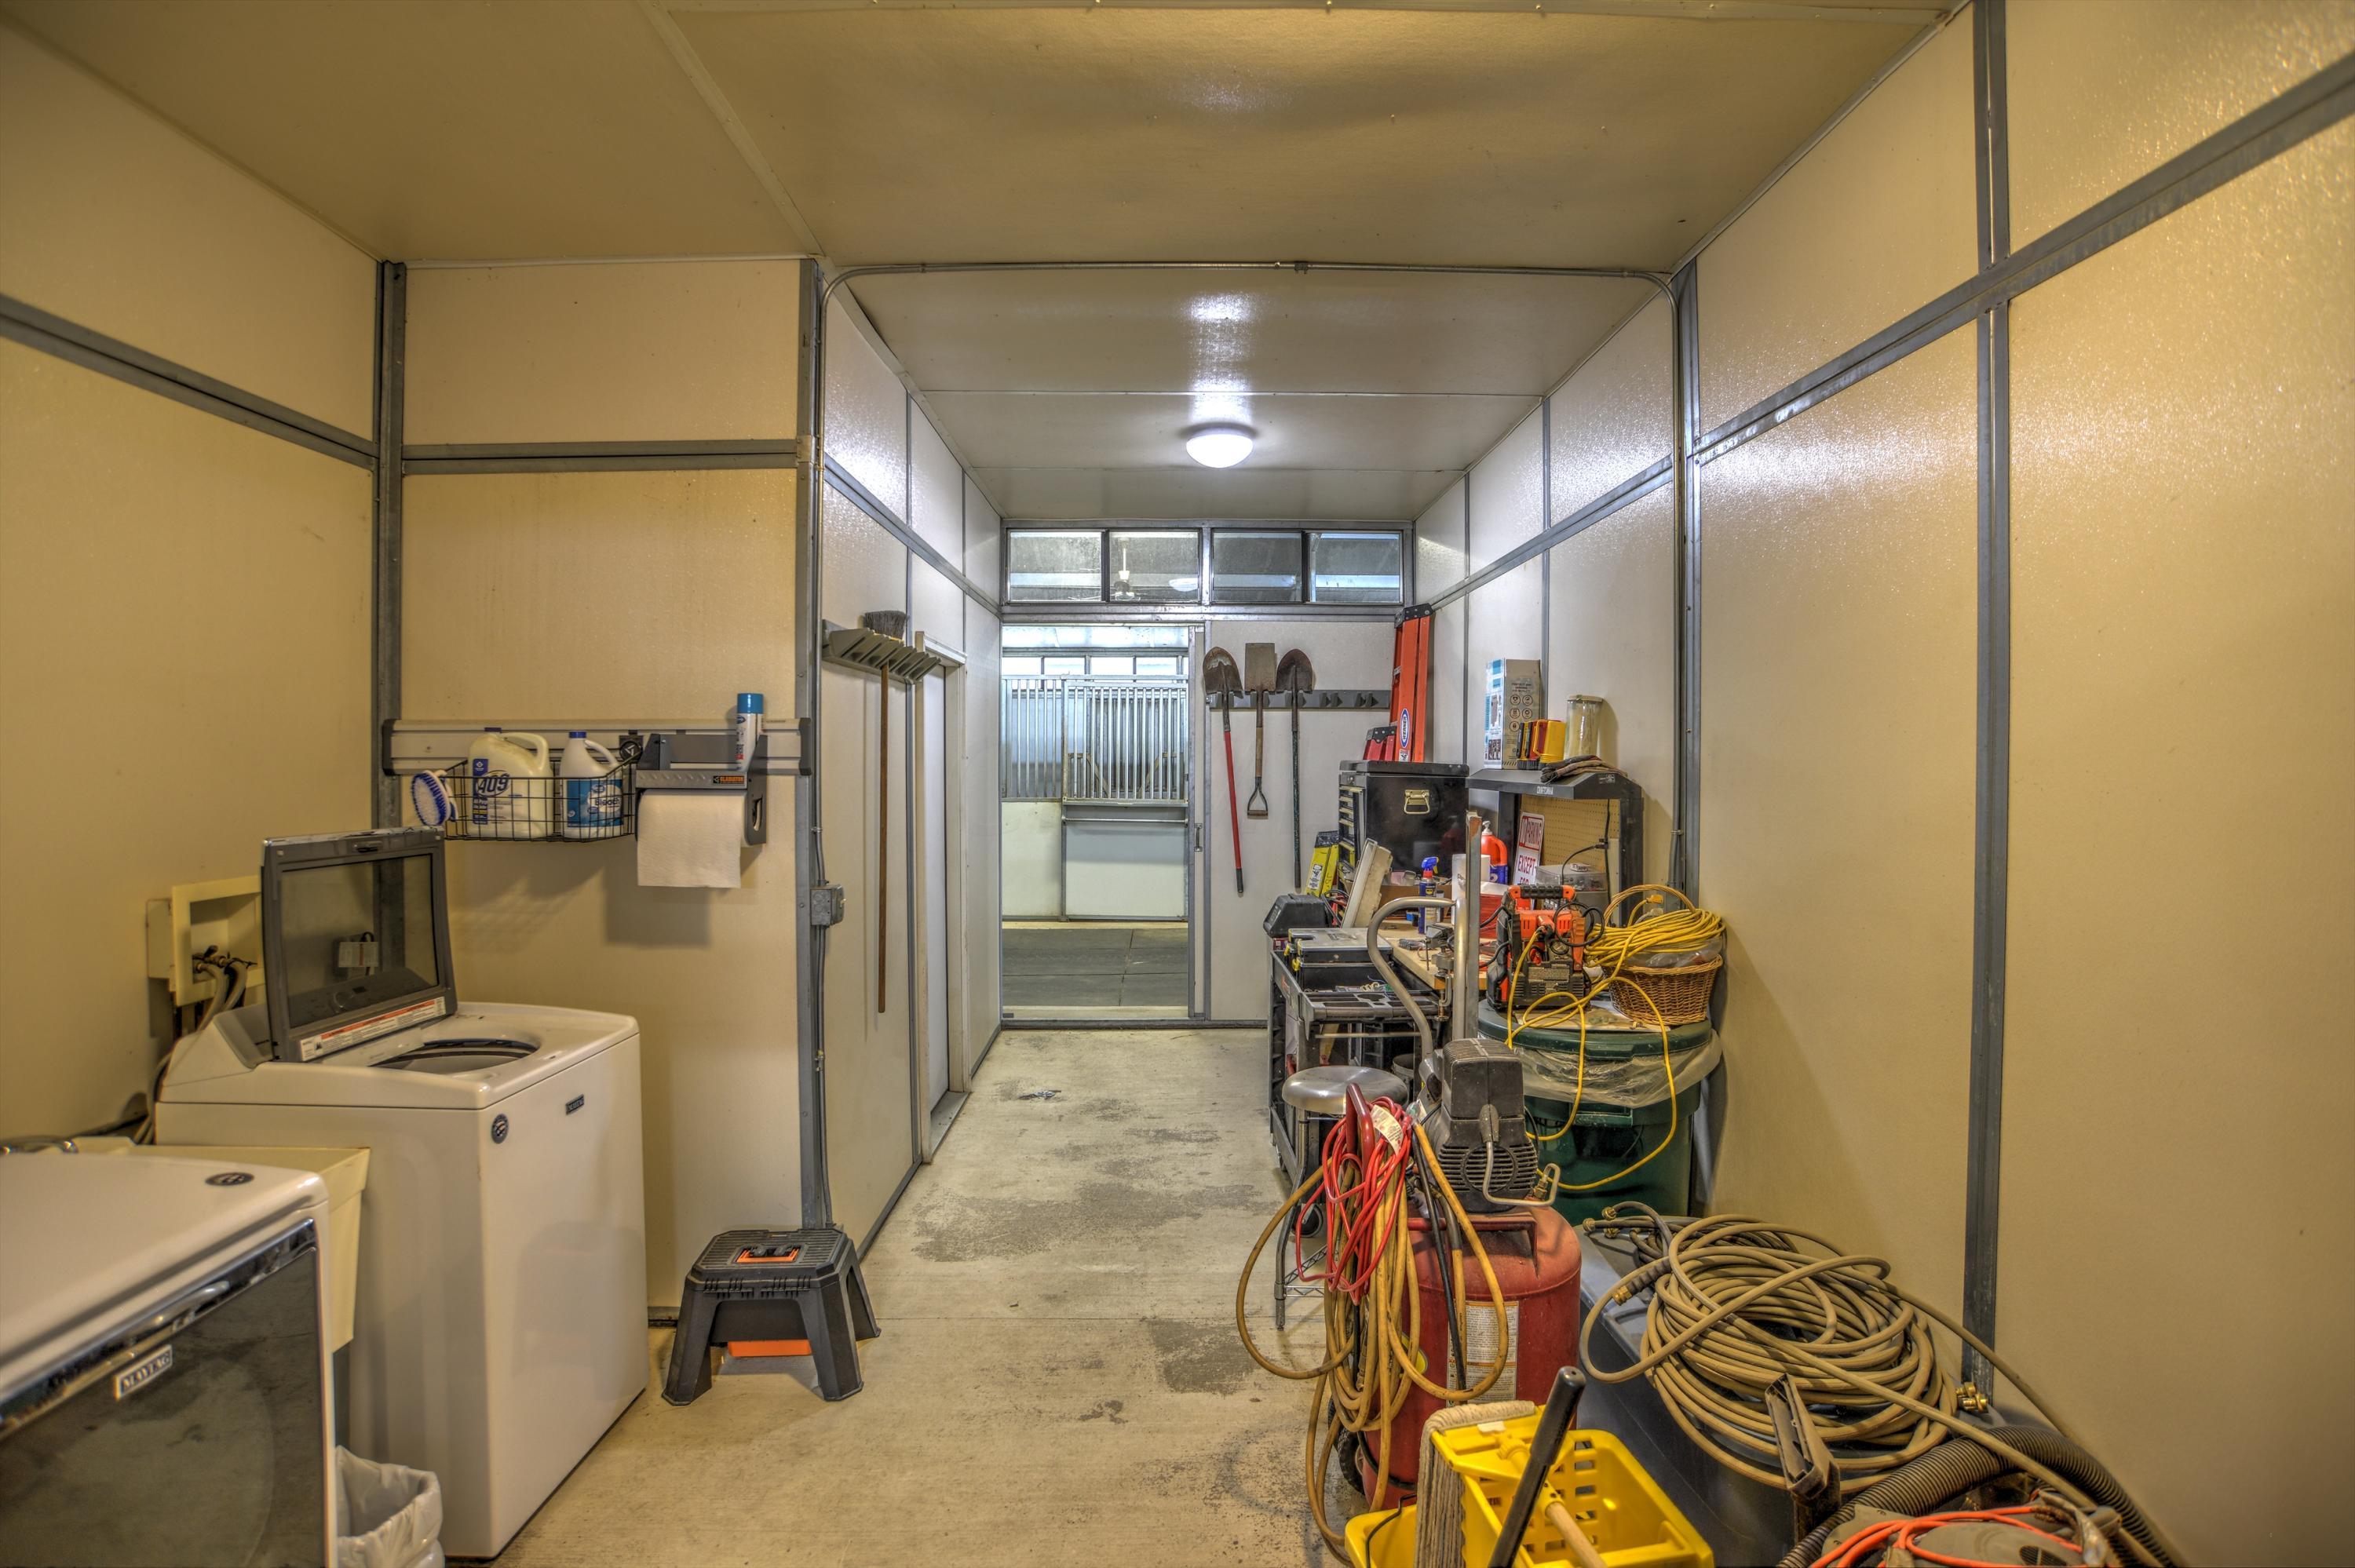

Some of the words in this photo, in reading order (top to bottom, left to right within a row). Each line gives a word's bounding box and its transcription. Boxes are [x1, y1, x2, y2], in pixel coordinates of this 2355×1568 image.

[477, 773, 509, 793] 409
[1518, 855, 1536, 876] EXCEPT
[120, 1351, 170, 1395] MAYTAG
